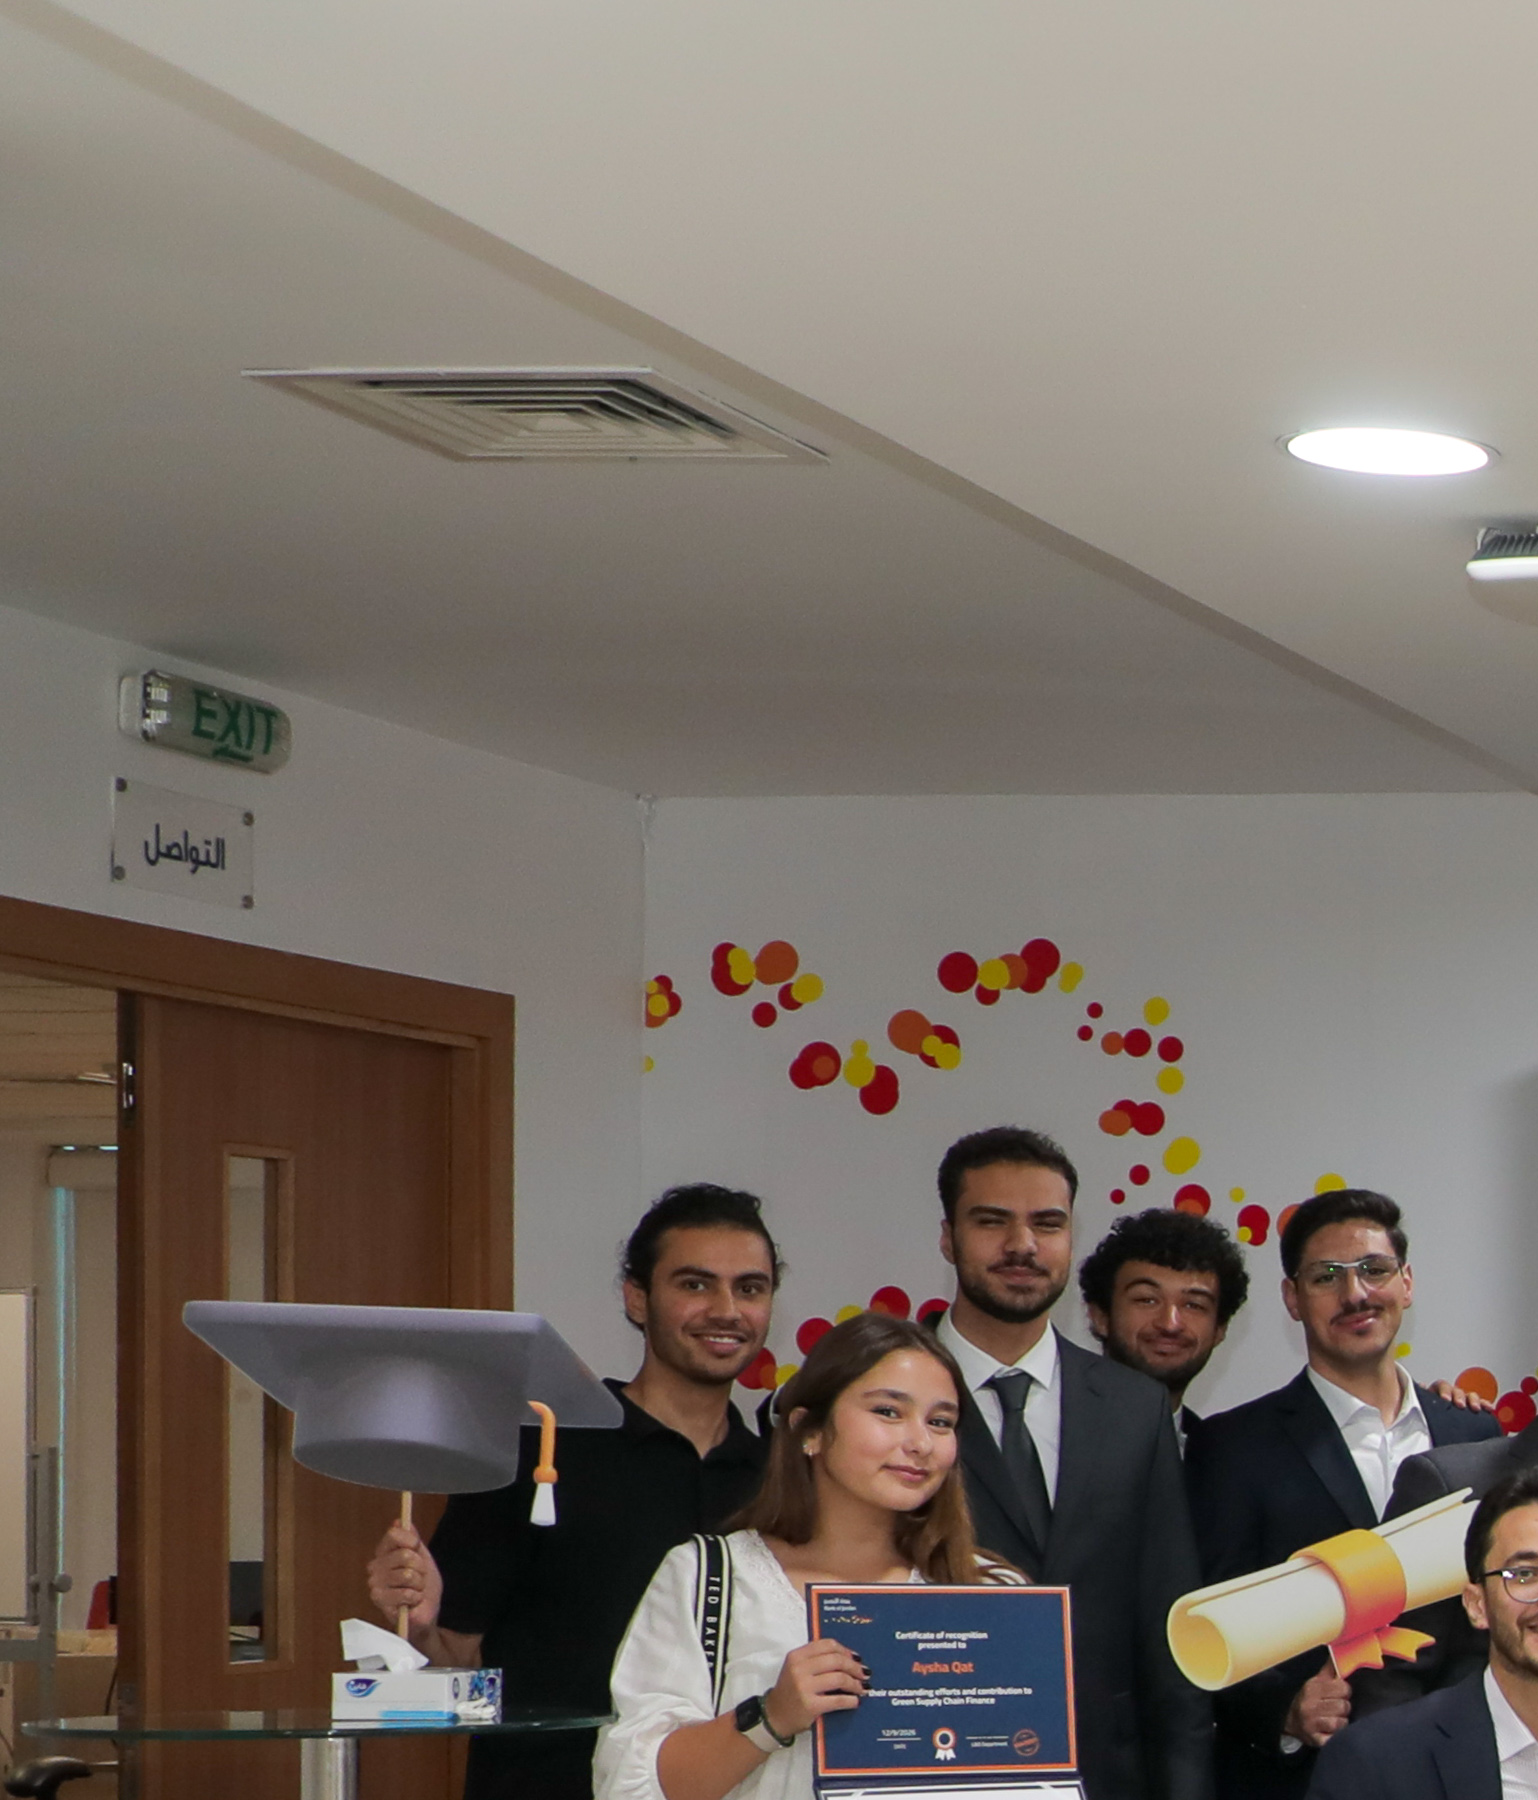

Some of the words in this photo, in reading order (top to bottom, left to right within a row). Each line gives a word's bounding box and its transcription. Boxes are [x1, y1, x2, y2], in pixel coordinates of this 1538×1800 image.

[192, 688, 278, 755] EXIT
[144, 823, 225, 875] التواصل
[895, 1631, 935, 1640] Certificate
[935, 1631, 945, 1639] of
[944, 1631, 988, 1641] recognition
[918, 1641, 957, 1651] presented
[957, 1641, 967, 1649] to
[912, 1662, 950, 1675] Aysha
[951, 1661, 974, 1674] Qat
[891, 1698, 915, 1706] Green
[915, 1696, 942, 1707] Supply
[942, 1697, 965, 1705] Chain
[965, 1696, 996, 1704] Finance
